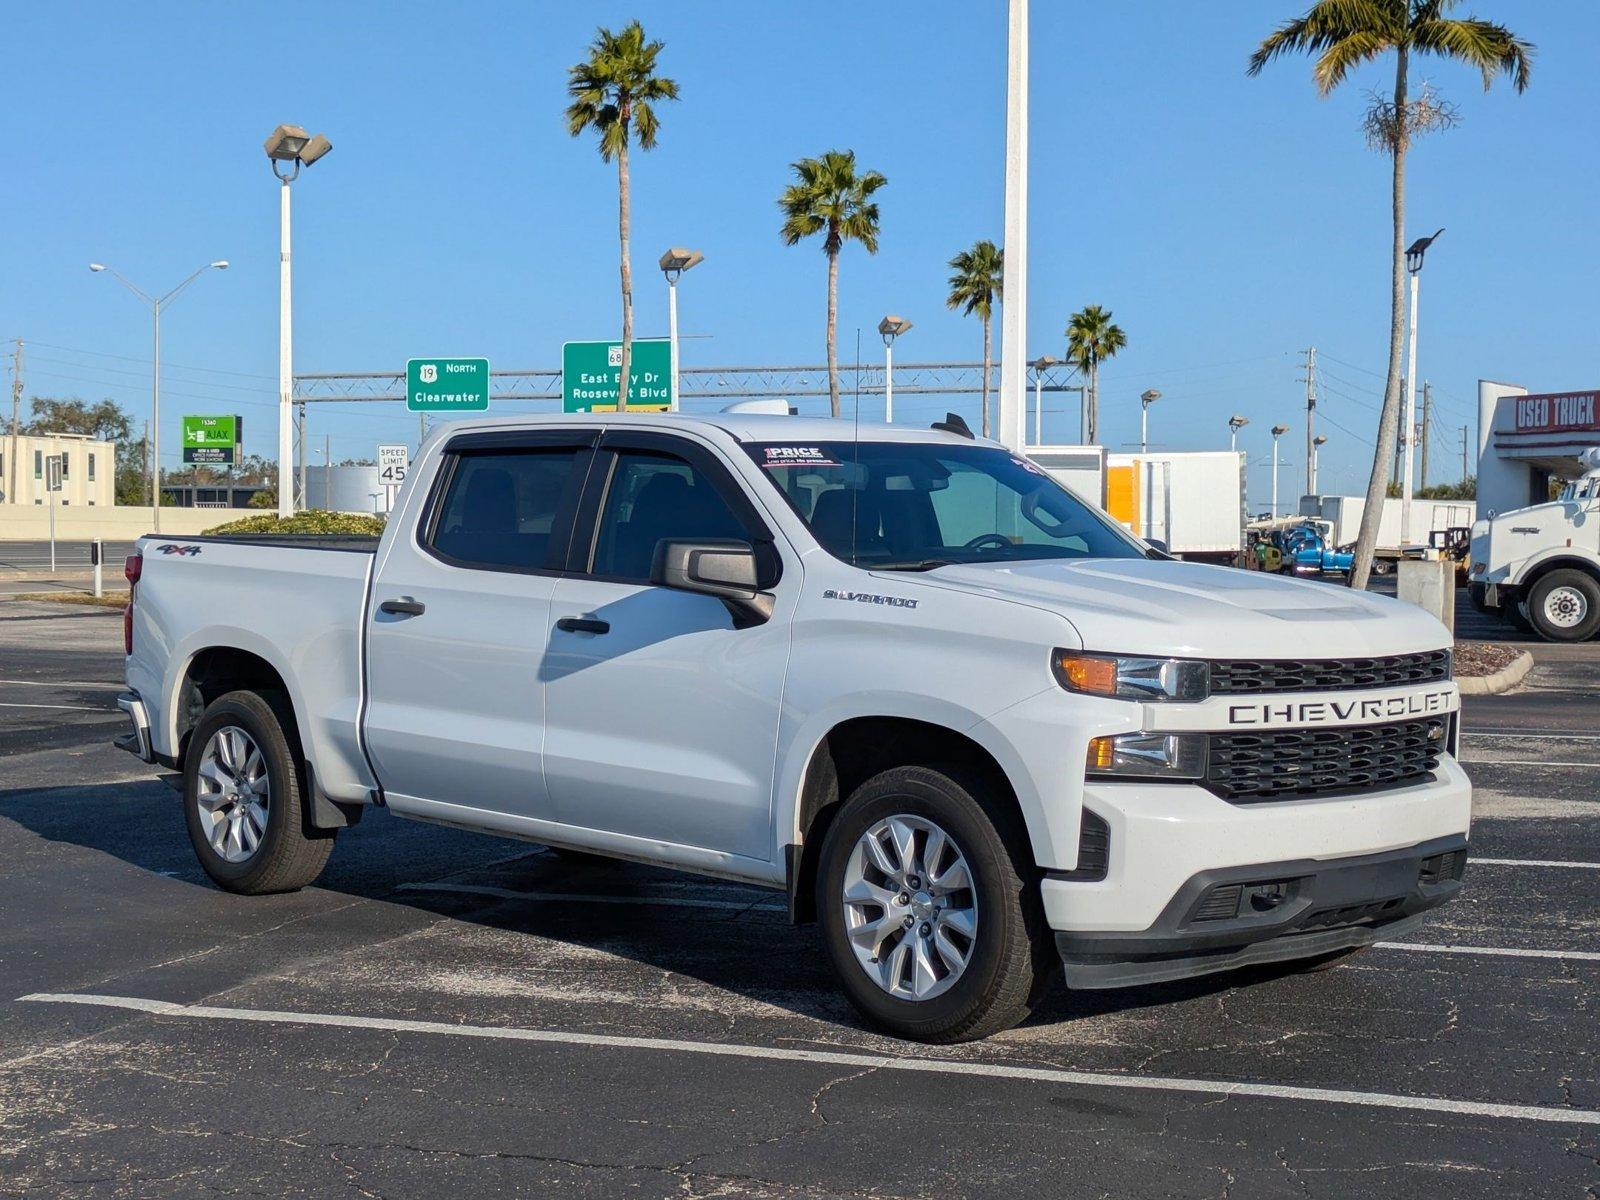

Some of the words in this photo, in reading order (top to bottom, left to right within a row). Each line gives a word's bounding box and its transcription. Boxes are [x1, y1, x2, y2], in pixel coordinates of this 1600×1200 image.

[609, 354, 622, 363] 68
[424, 369, 434, 379] 19
[446, 364, 476, 373] NORTH
[581, 373, 608, 383] East
[615, 373, 639, 385] By
[645, 373, 659, 382] Dr
[415, 392, 480, 402] Clearwater
[573, 388, 634, 398] Roosevt
[640, 388, 668, 397] Blvd
[1518, 398, 1549, 427] USED
[1554, 396, 1595, 426] TRUCK
[206, 430, 228, 440] AJAX
[383, 457, 402, 465] LIMIT
[382, 466, 405, 481] 45
[823, 589, 918, 608] SILVERADO
[1229, 691, 1453, 724] CHEVROLET
